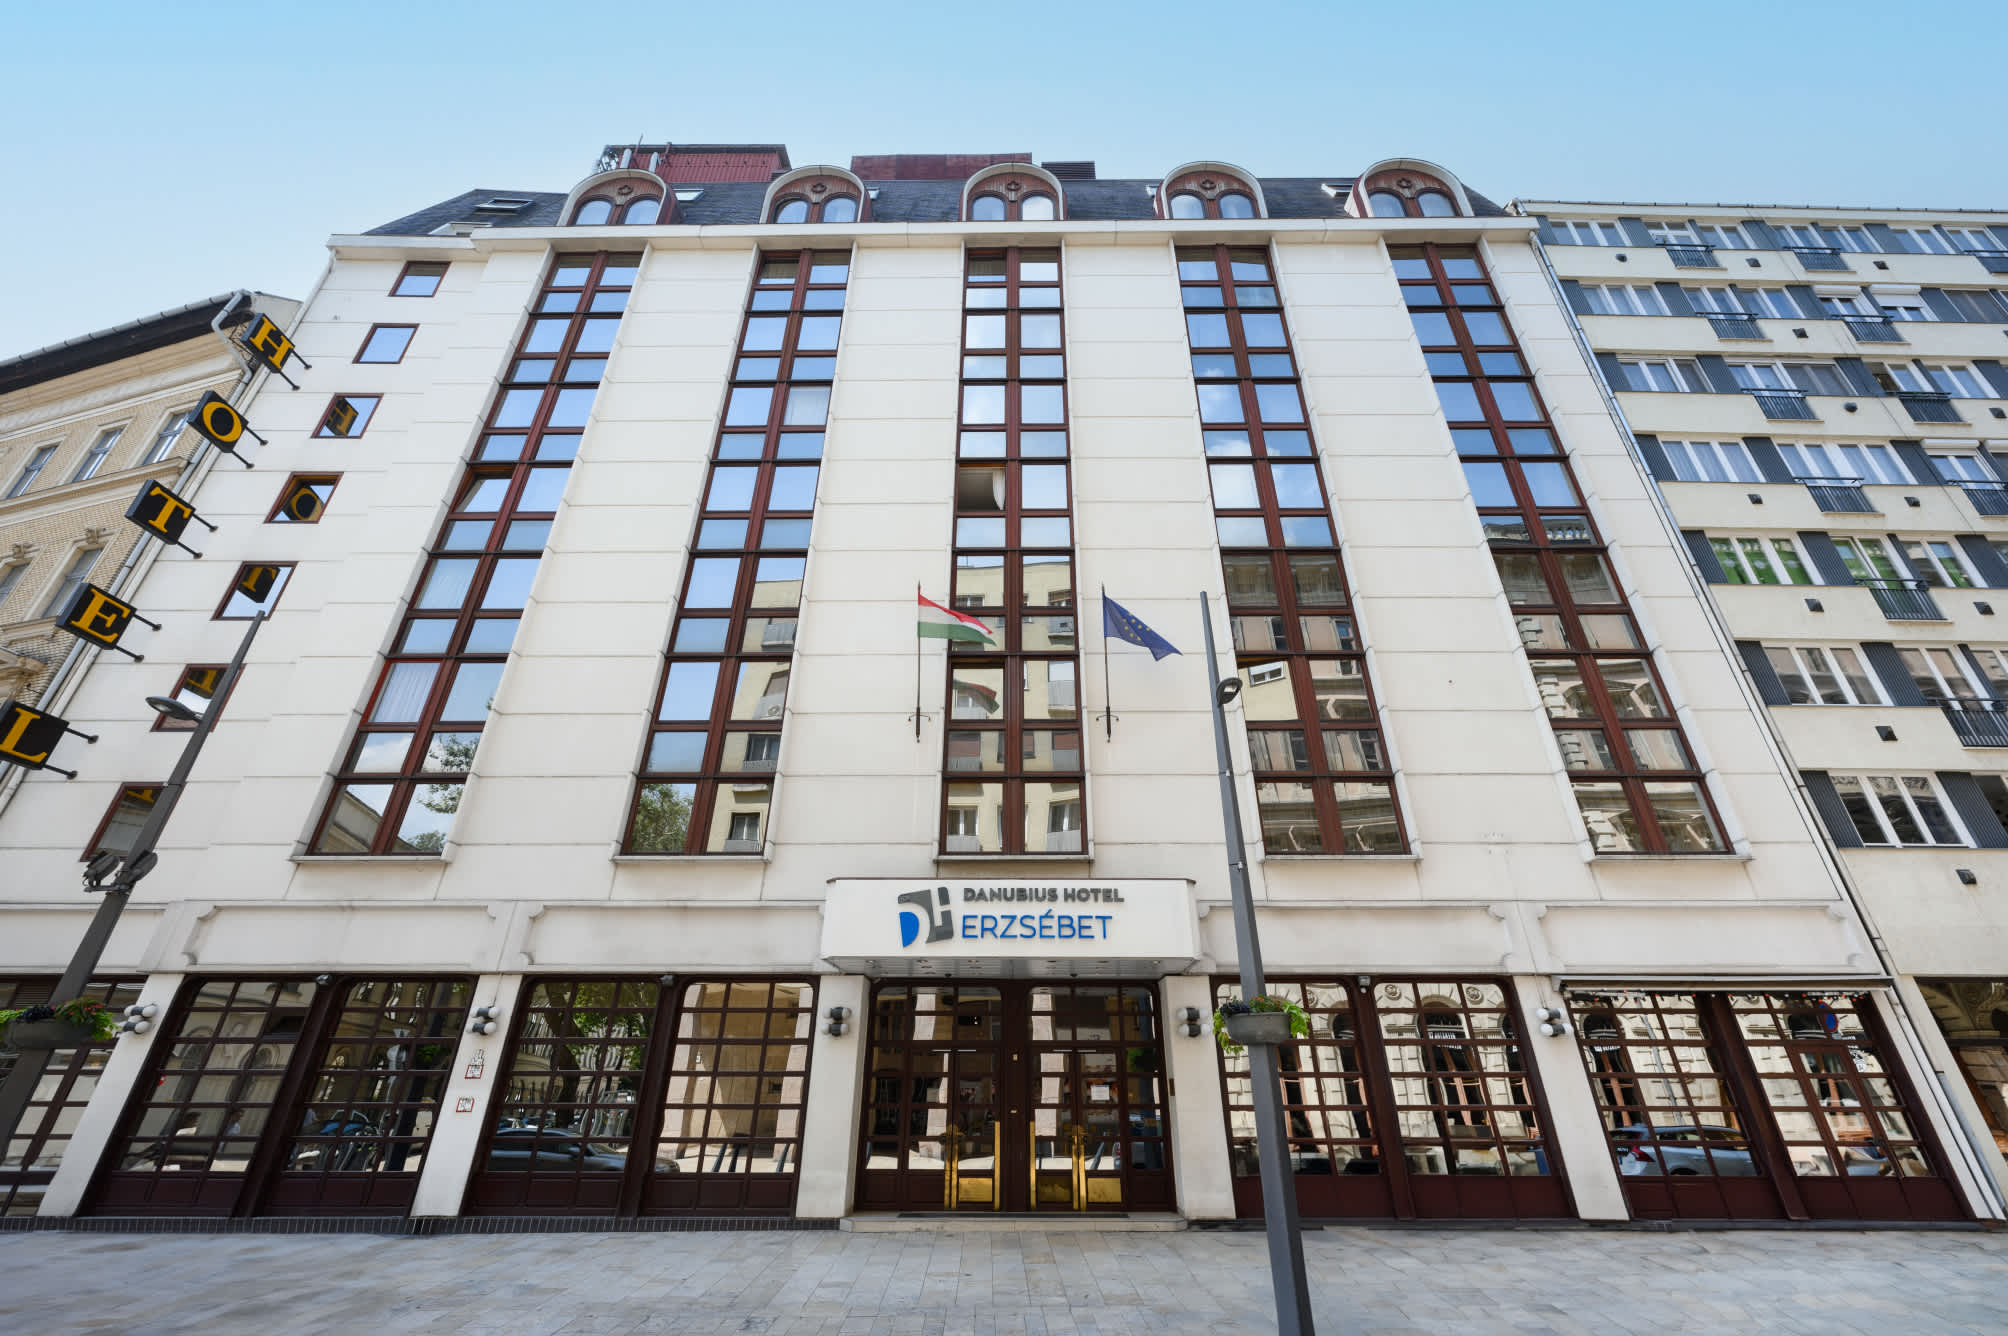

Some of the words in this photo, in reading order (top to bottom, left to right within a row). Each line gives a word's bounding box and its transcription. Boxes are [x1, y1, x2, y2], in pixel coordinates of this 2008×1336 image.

[0, 316, 295, 763] HOTEL
[963, 887, 1058, 902] DANUBIUS
[1063, 887, 1125, 903] HOTEL
[961, 908, 1113, 939] ERZSÉBET
